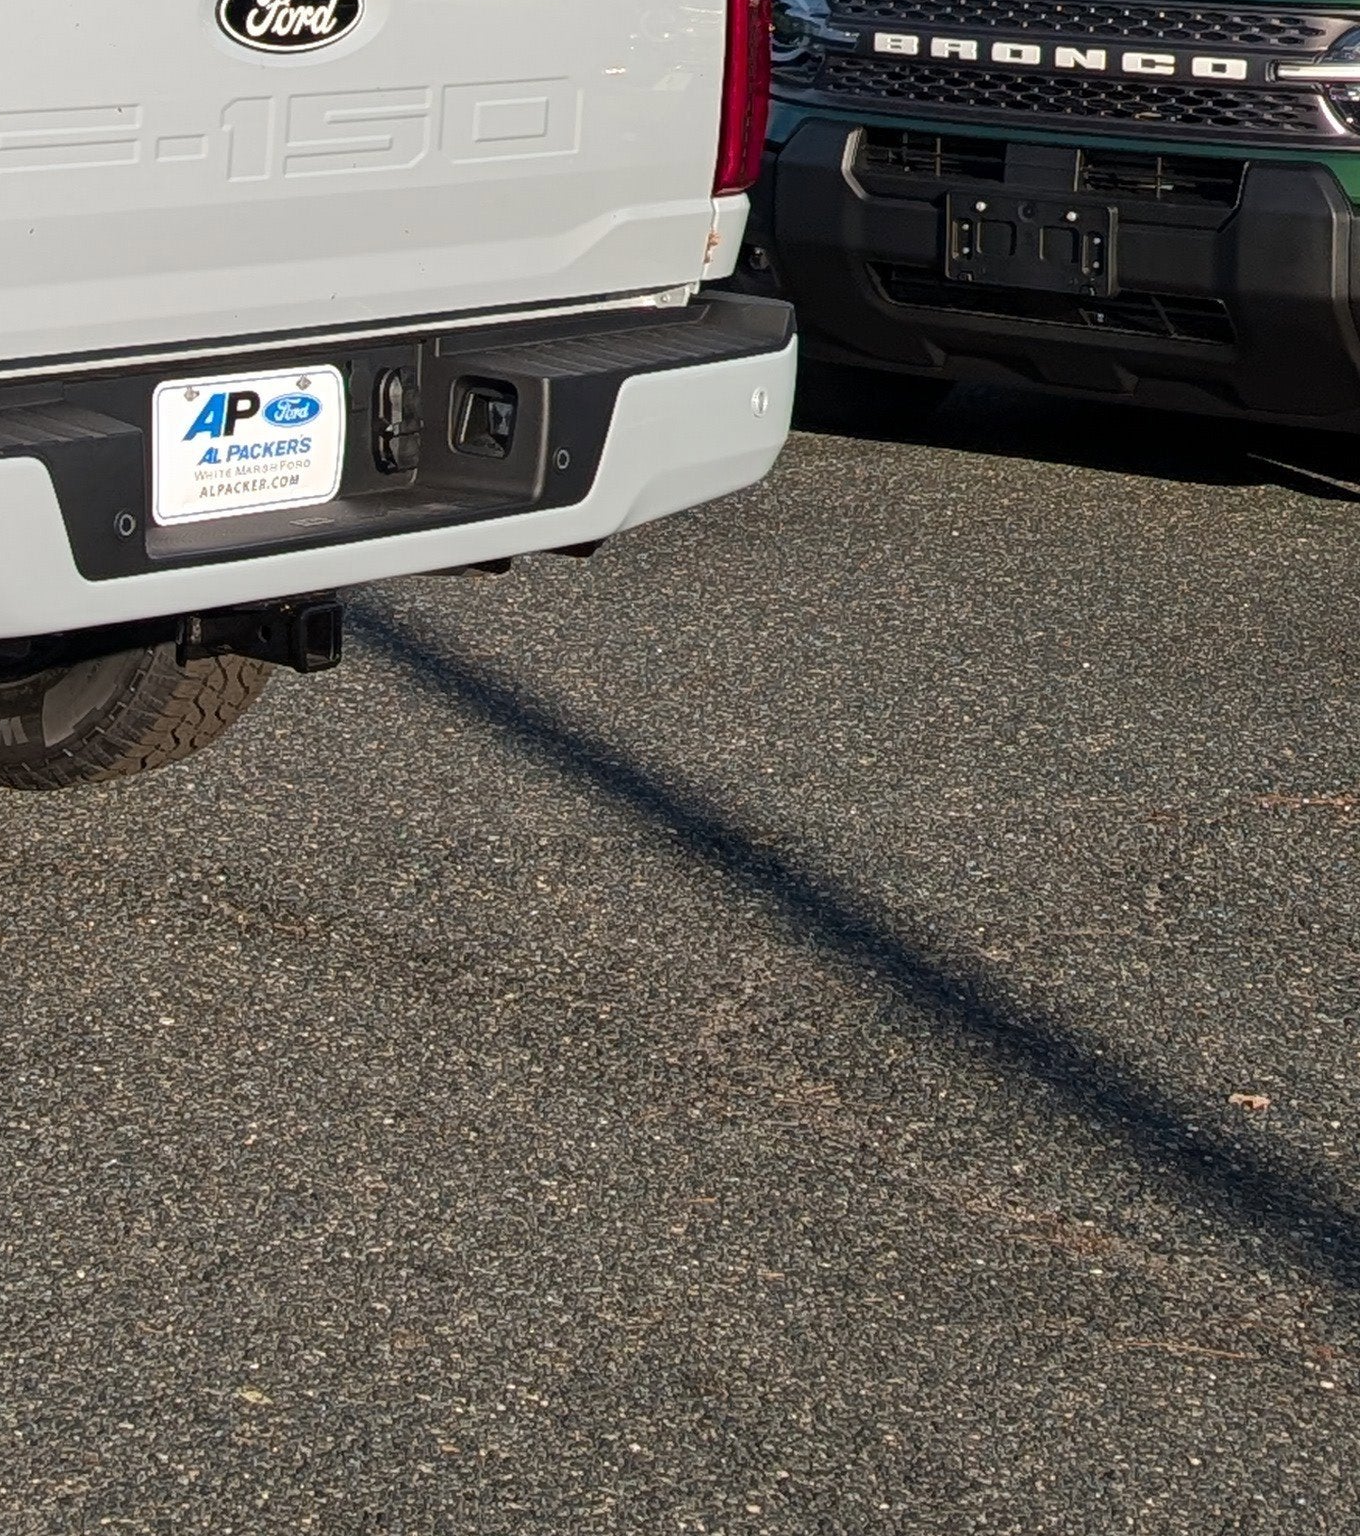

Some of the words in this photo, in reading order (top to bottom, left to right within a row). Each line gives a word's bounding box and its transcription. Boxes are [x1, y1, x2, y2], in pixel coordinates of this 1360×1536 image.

[873, 31, 1248, 81] BRONCO
[182, 390, 261, 441] AP
[196, 446, 222, 466] AL
[198, 474, 300, 498] ALPACKER.COM
